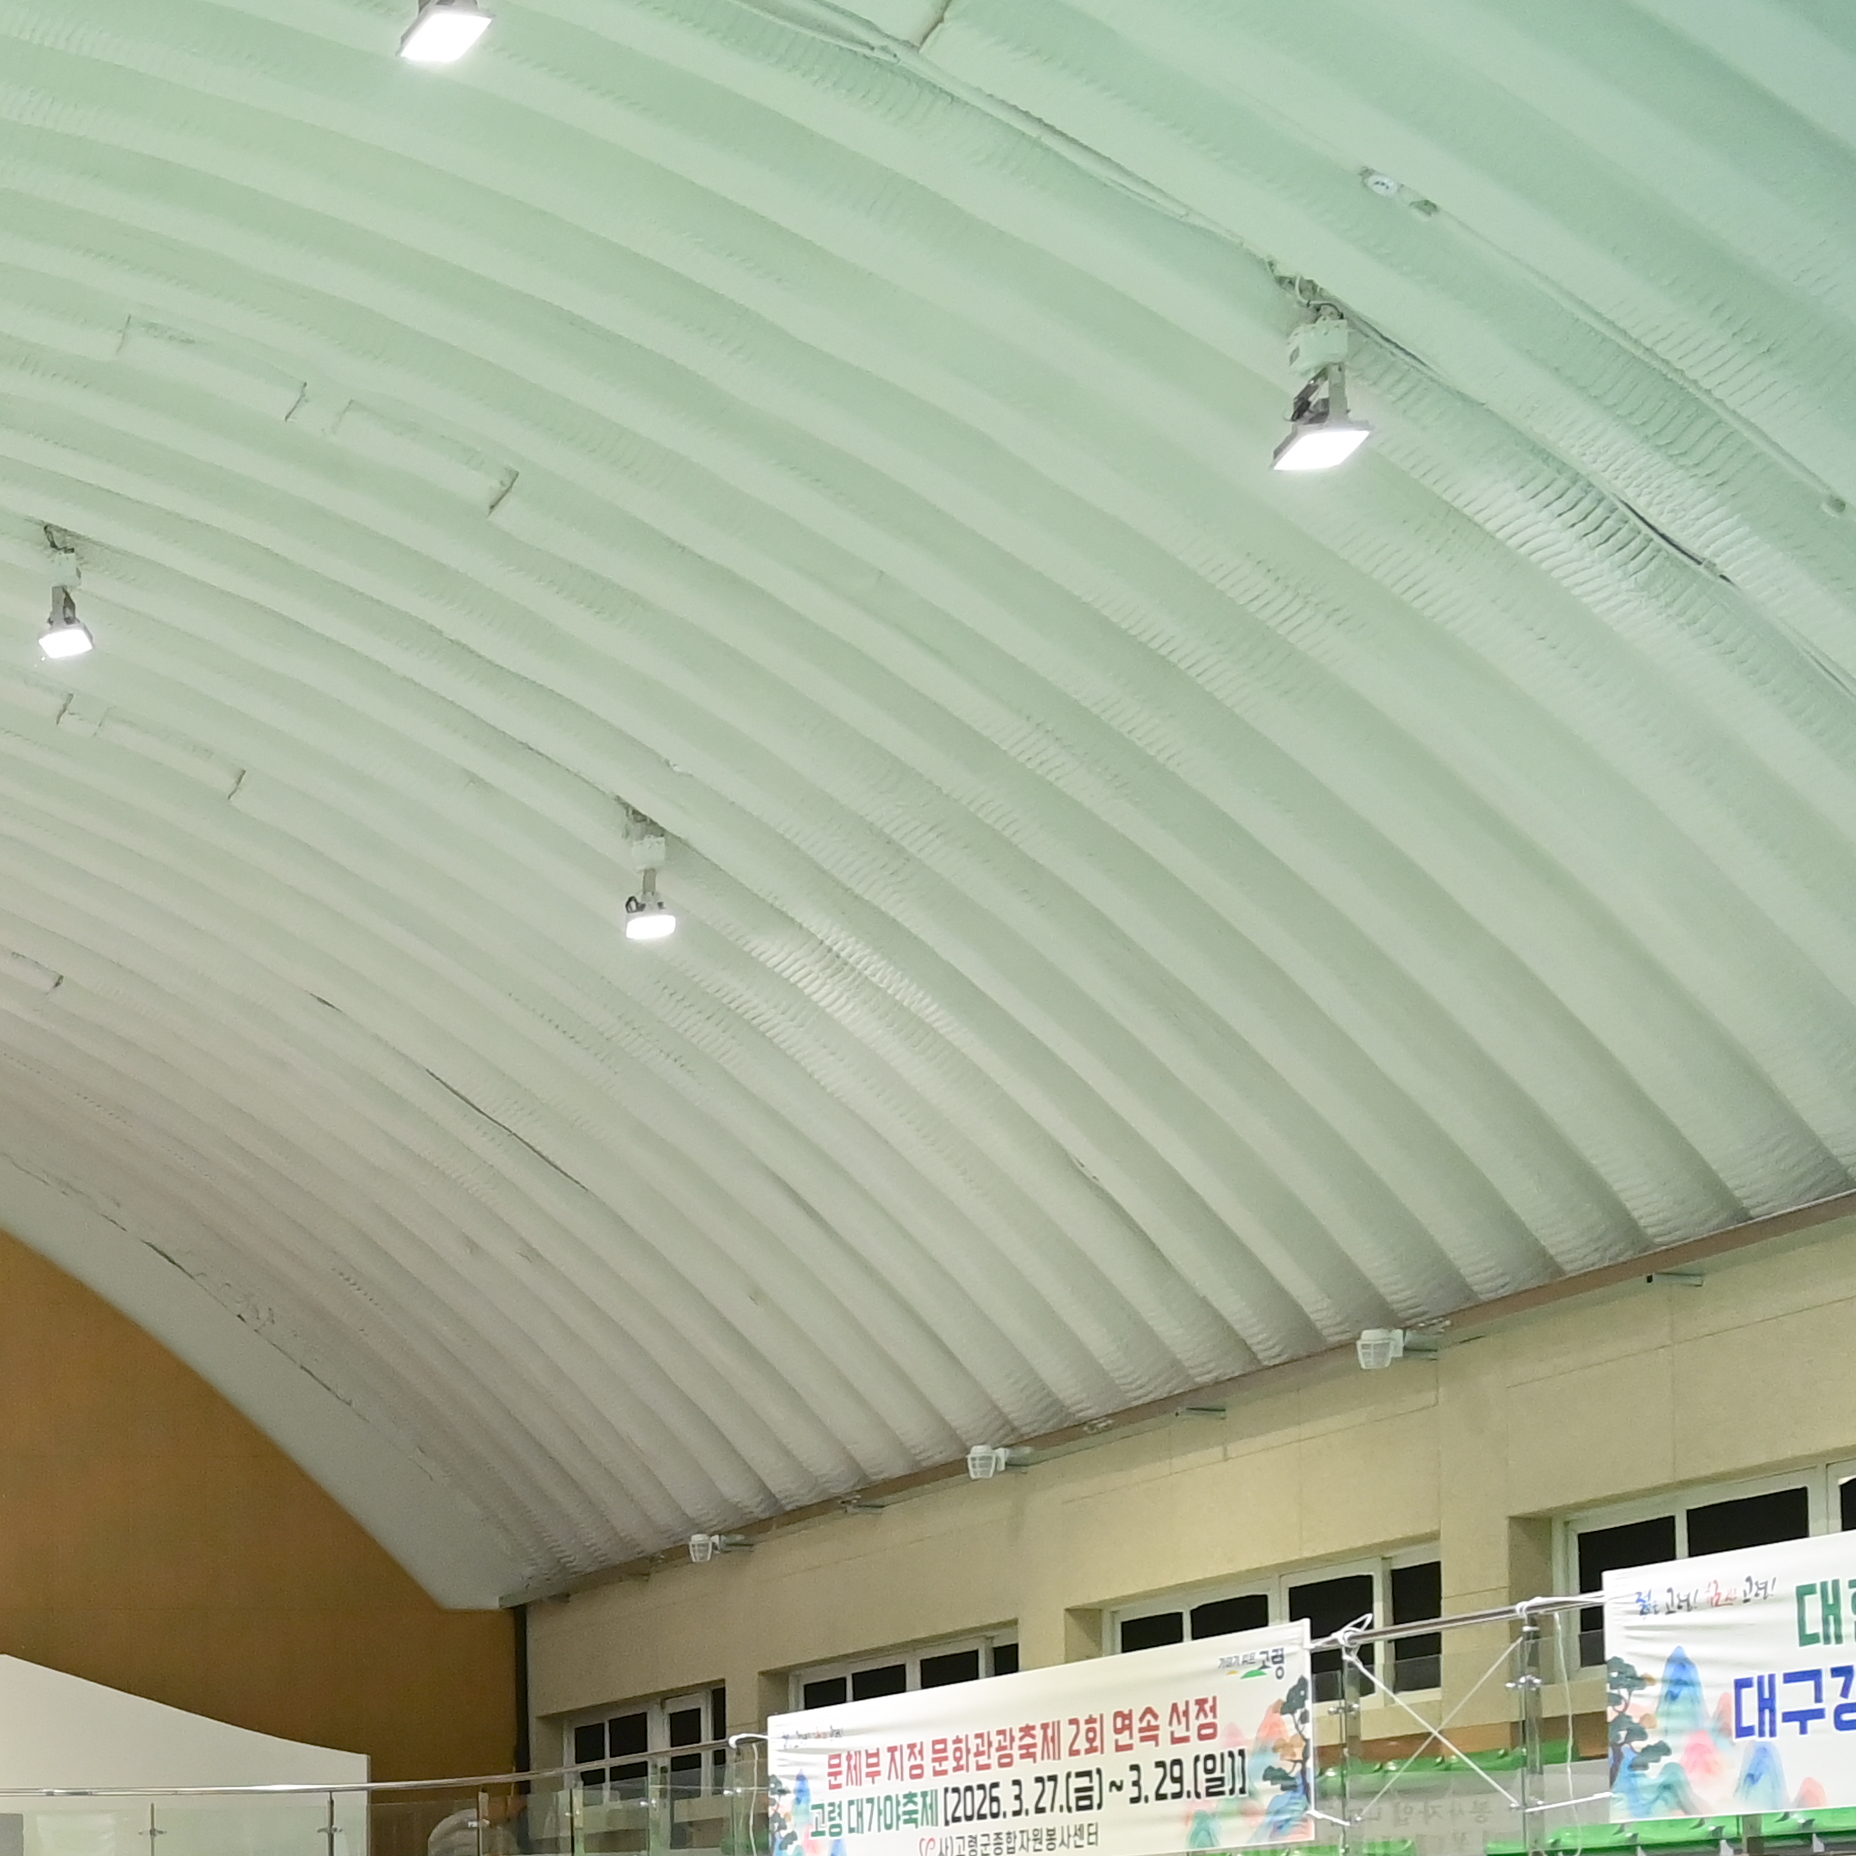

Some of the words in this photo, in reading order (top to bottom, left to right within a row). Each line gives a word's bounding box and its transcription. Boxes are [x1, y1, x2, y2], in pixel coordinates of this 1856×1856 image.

[1795, 1578, 1856, 1647] 대
[1259, 1647, 1285, 1680] 고령
[827, 1747, 881, 1790] 문체부
[888, 1741, 924, 1782] 지정
[931, 1719, 1061, 1777] 문화관광축제
[1068, 1713, 1105, 1757] 2회
[1113, 1706, 1159, 1753] 연속
[1168, 1696, 1218, 1745] 선정
[810, 1800, 843, 1838] 고령
[847, 1789, 938, 1835] 대가야축제
